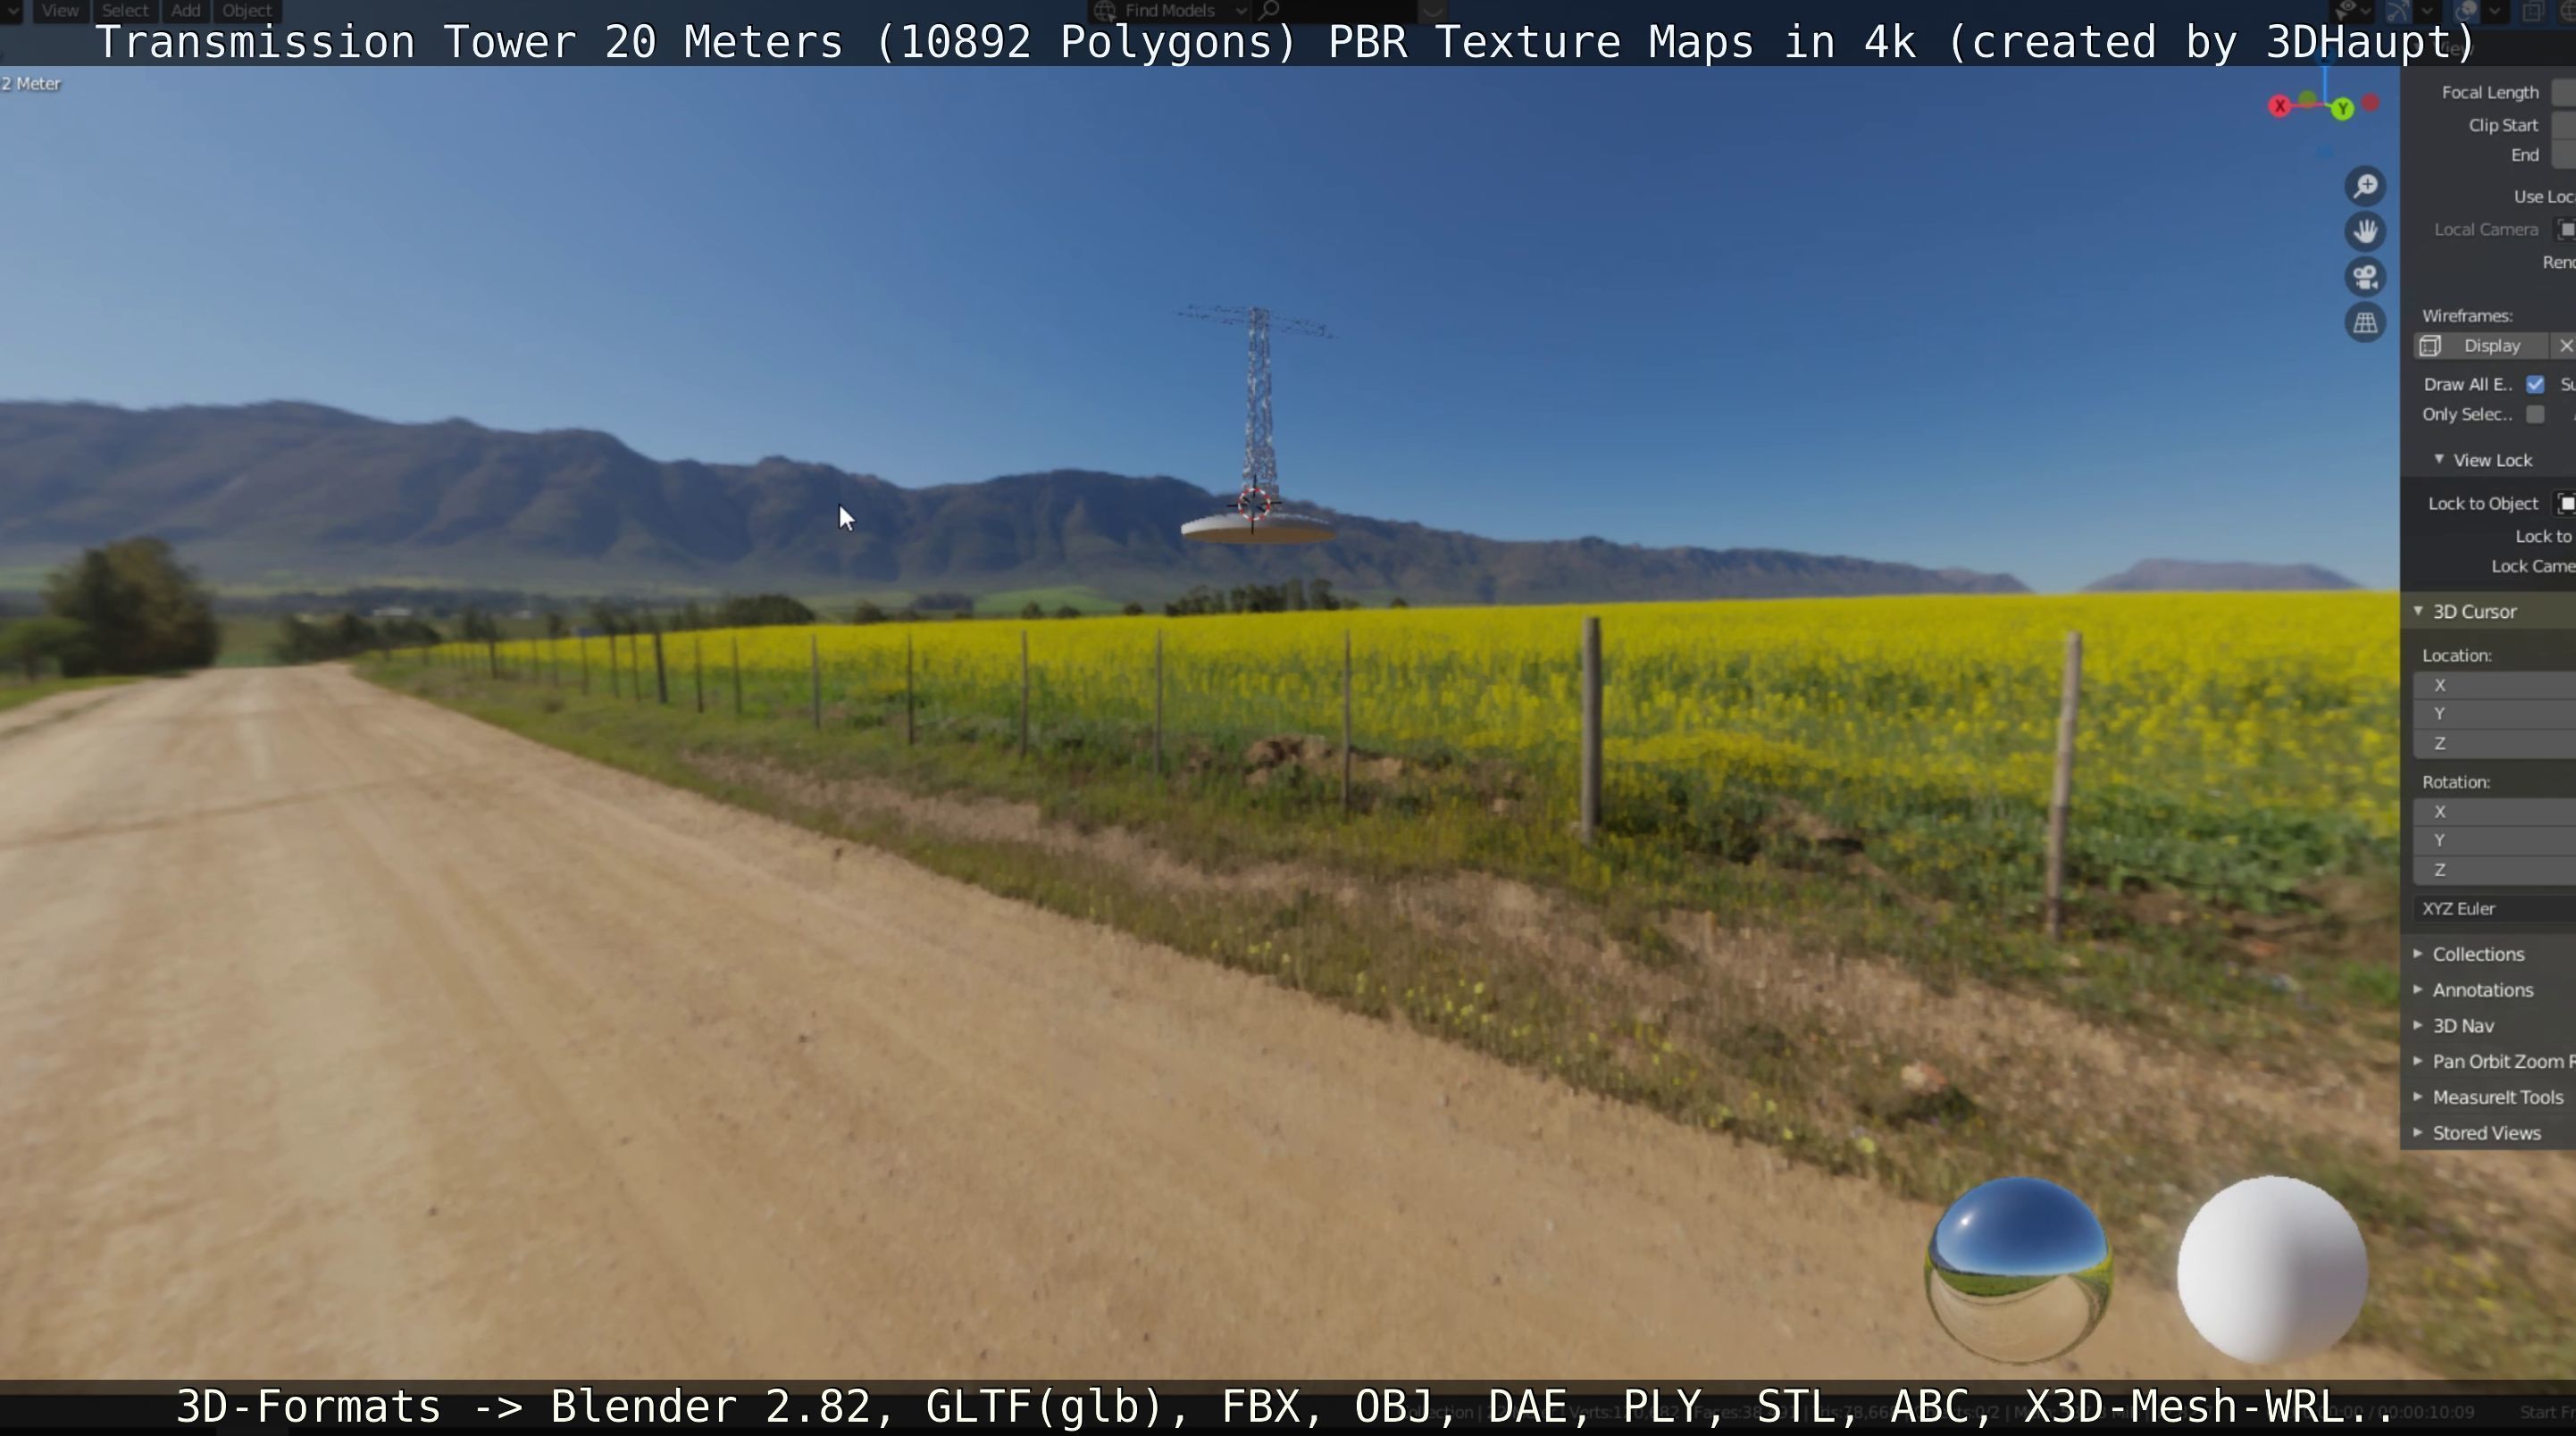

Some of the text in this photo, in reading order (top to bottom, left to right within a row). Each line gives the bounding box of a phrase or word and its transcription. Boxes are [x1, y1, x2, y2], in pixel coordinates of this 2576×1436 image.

[41, 4, 79, 18] View
[102, 4, 149, 18] Select
[171, 3, 201, 18] Add
[222, 3, 272, 21] Object
[1126, 3, 1216, 18] Find Models
[17, 77, 61, 90] Meter
[2443, 85, 2539, 103] Focal Length
[2469, 118, 2539, 136] Clip Start
[2512, 147, 2539, 162] End
[2514, 189, 2544, 204] Use
[2435, 221, 2539, 237] Local Camera
[2422, 308, 2513, 323] Wireframes:
[2465, 338, 2522, 355] Display
[2424, 377, 2513, 391] Draw All E..
[2422, 406, 2513, 424] Only Selec..
[2454, 453, 2533, 468] View Lock
[2430, 497, 2539, 513] Lock to Object
[2516, 529, 2572, 543] Lock to
[2492, 559, 2529, 573] Lock
[2433, 604, 2518, 620] 3D Cursor
[2423, 648, 2491, 663] Location:
[2434, 678, 2446, 692] X
[2434, 706, 2446, 721] Y
[2434, 736, 2446, 750] Z
[2423, 775, 2490, 789] Rotation:
[2434, 805, 2446, 819] X
[2434, 833, 2446, 847] Y
[2434, 863, 2446, 877] Z
[2423, 901, 2496, 916] XYZ Euler
[2433, 947, 2526, 962] Collections
[2432, 982, 2535, 998] Annotations
[2434, 1018, 2495, 1033] 3D Nav
[2433, 1054, 2465, 1069] Pan
[2469, 1054, 2512, 1069] Orbit
[2514, 1054, 2565, 1069] Zoom
[2433, 1090, 2564, 1105] MeasureIt Tools
[2433, 1125, 2542, 1141] Stored Views
[2520, 1405, 2558, 1420] Start
